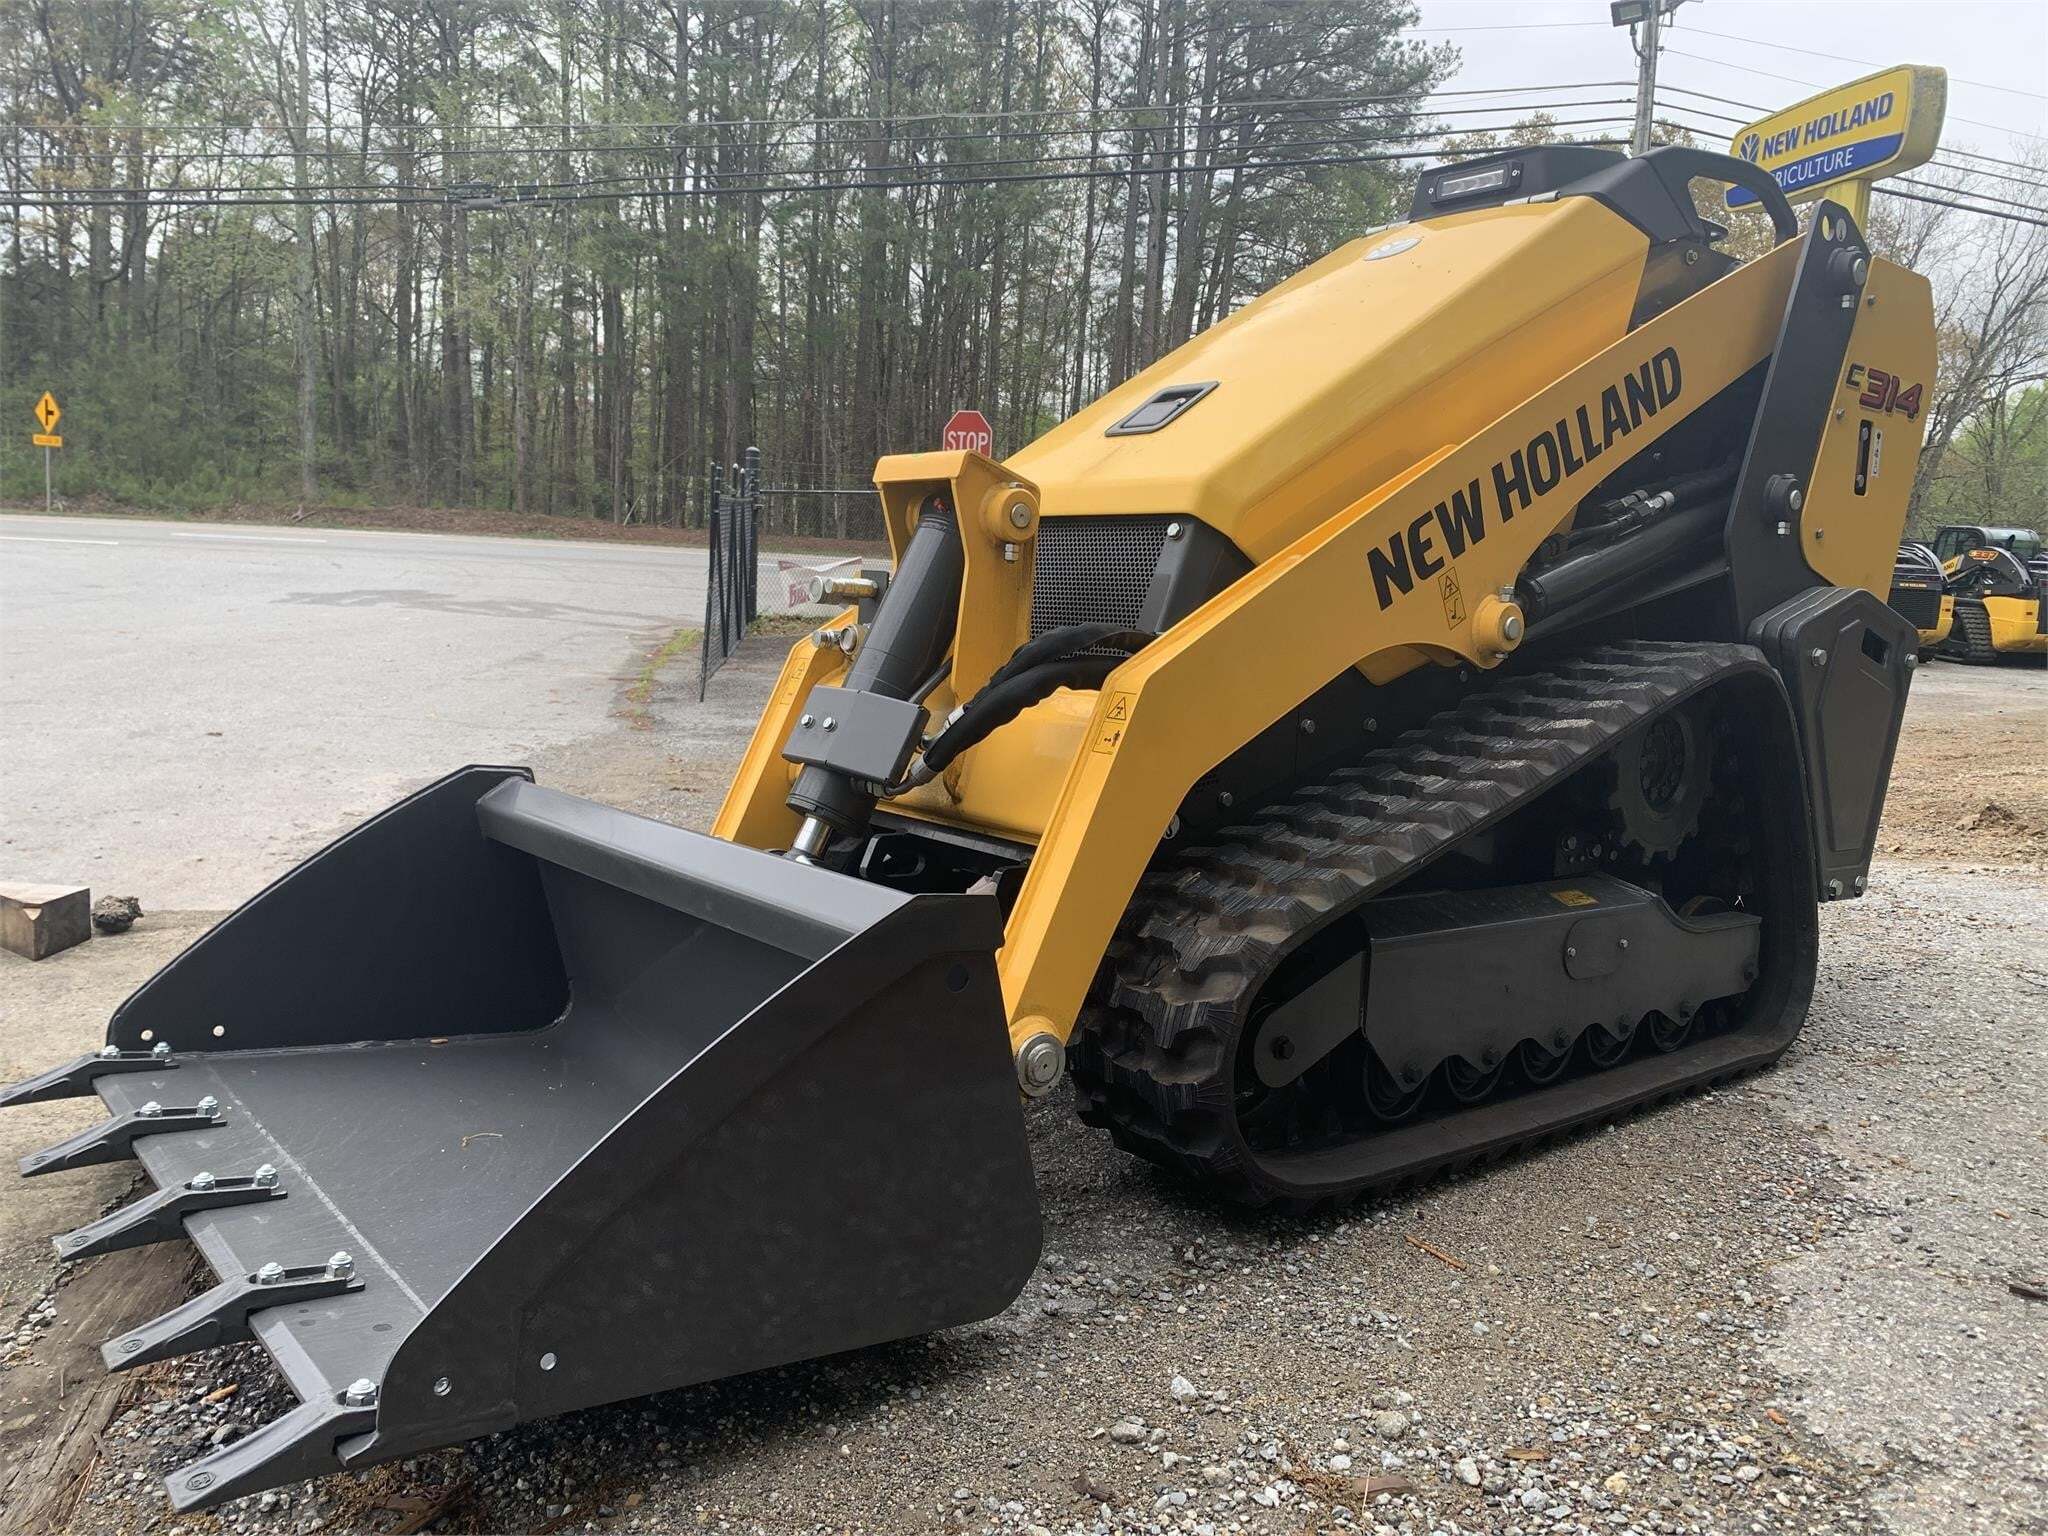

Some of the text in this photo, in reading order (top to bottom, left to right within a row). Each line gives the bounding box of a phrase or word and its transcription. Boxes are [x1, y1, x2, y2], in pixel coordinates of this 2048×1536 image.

[1762, 92, 1893, 160] NEW HOLLAND
[1773, 147, 1854, 187] RICULTURE
[947, 431, 988, 454] STOP
[1366, 346, 1682, 612] NEW HOLLAND
